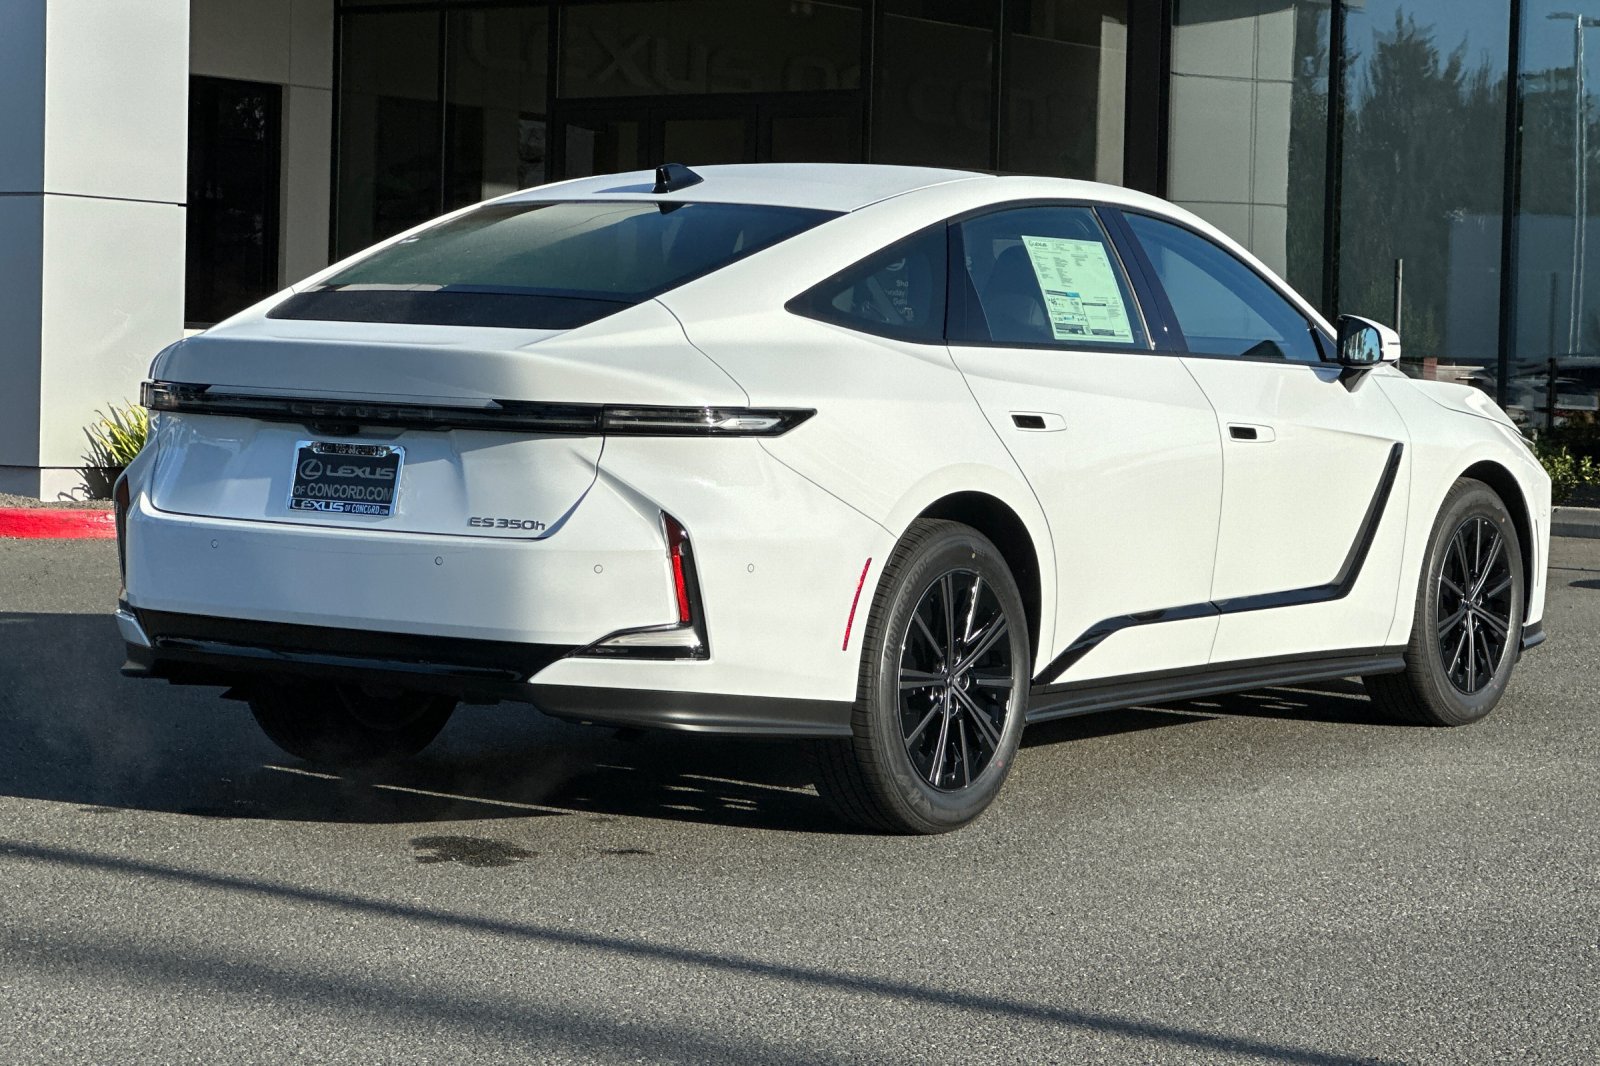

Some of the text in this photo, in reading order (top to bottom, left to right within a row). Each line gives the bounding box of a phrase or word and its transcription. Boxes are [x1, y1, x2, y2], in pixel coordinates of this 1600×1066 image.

[326, 464, 396, 480] LEXUS
[294, 482, 393, 501] OF CONCORD.COM
[291, 499, 345, 512] LEXUS
